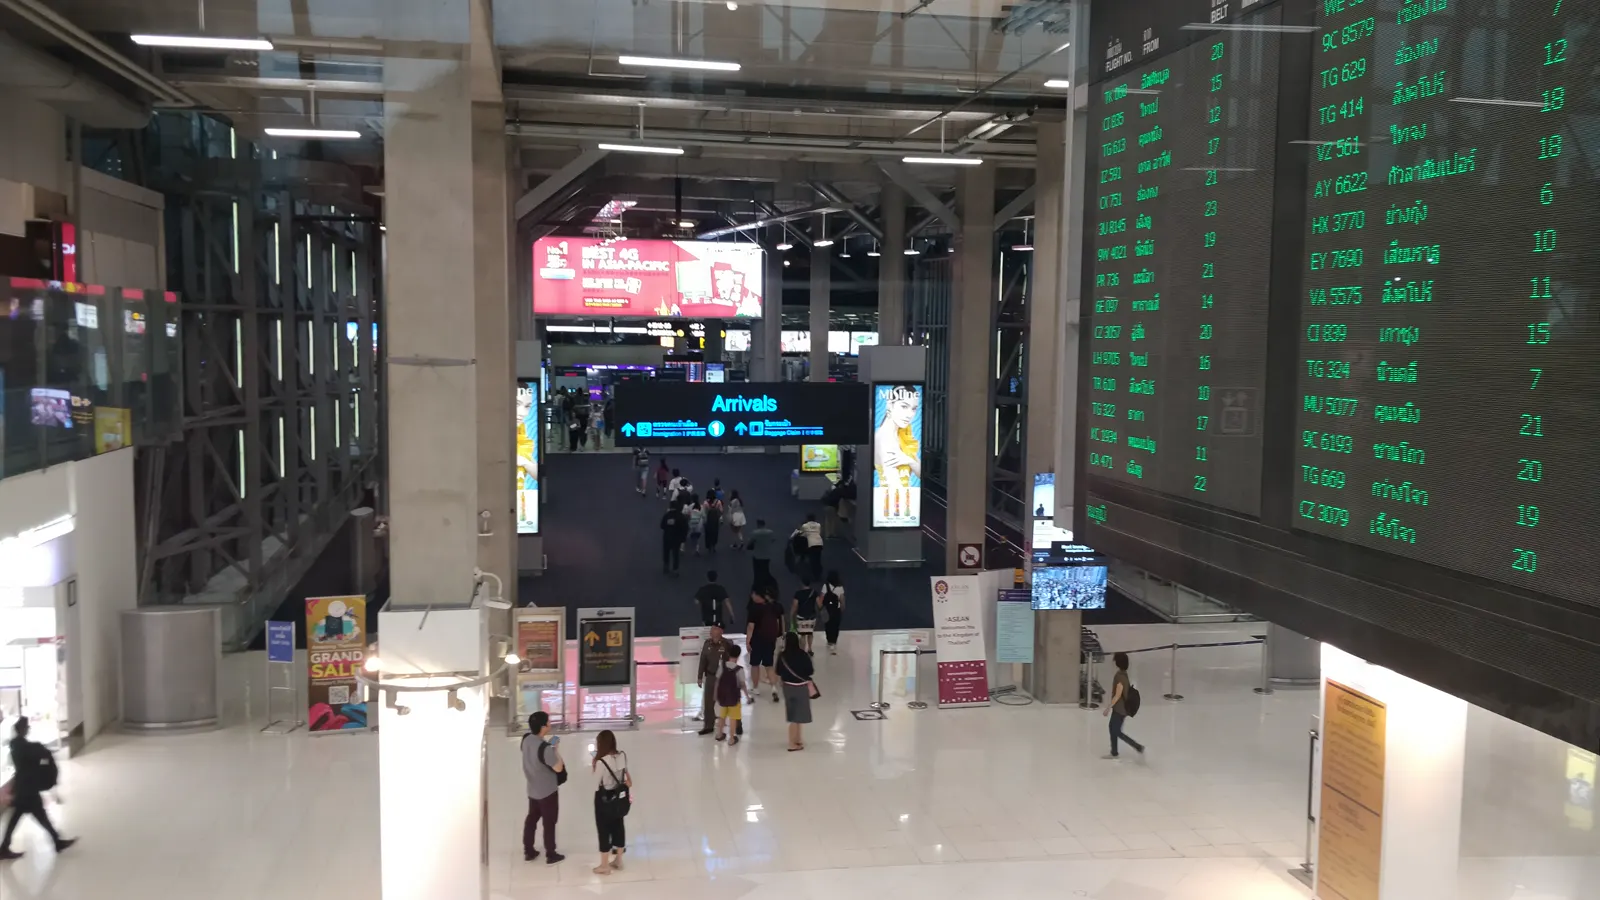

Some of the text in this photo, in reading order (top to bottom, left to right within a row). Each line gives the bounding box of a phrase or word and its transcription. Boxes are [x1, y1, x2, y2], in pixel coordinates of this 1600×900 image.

[1211, 4, 1229, 24] BELT
[1323, 30, 1338, 52] 9C
[1341, 17, 1374, 45] 8579
[1142, 38, 1159, 55] FROM
[1211, 42, 1224, 60] 20
[1105, 51, 1133, 72] FLIGHT NO.
[1321, 67, 1338, 88] TG
[1341, 58, 1366, 82] 629
[1394, 38, 1439, 66] ฮ่องกง
[1211, 74, 1222, 92] 15
[1320, 104, 1336, 124] TG
[1340, 97, 1363, 118] 414
[1544, 39, 1568, 65] 12
[1103, 142, 1112, 156] TG
[1113, 138, 1126, 154] 613
[1209, 106, 1221, 123] 12
[1317, 87, 1565, 161] VZ 561 ไทจง 18
[1208, 137, 1220, 154] 17
[1314, 180, 1331, 198] AY
[1335, 172, 1368, 194] 6622
[1538, 134, 1562, 159] 18
[1110, 193, 1122, 206] 751
[1205, 170, 1217, 185] 21
[1204, 200, 1217, 216] 23
[1312, 216, 1329, 233] HX
[1333, 210, 1365, 231] 3770
[1540, 183, 1553, 204] 6
[1205, 232, 1216, 247] 19
[582, 246, 639, 260] BEST 4G
[1310, 252, 1327, 270] EY
[1332, 249, 1363, 268] 7690
[1533, 230, 1556, 252] 10
[582, 259, 670, 271] IN ASIA-PACIFIC
[1202, 264, 1214, 278] 21
[1310, 289, 1326, 305] VA
[1330, 286, 1362, 305] 5575
[1530, 277, 1552, 299] 11
[1202, 294, 1213, 308] 14
[1200, 324, 1212, 339] 20
[1307, 324, 1319, 341] CI
[1322, 324, 1347, 341] 839
[1527, 322, 1550, 344] 15
[1200, 356, 1210, 370] 16
[1307, 360, 1324, 377] TG
[1326, 361, 1350, 378] 324
[1530, 369, 1542, 389] 7
[1198, 386, 1210, 400] 10
[711, 395, 778, 412] Arrivals
[1197, 416, 1208, 430] 17
[1304, 395, 1323, 413] MU
[1326, 397, 1358, 416] 5077
[1520, 414, 1543, 436] 21
[1196, 446, 1206, 461] 11
[1303, 431, 1318, 448] 9C
[1320, 433, 1352, 454] 6193
[1517, 459, 1542, 482] 20
[1194, 475, 1206, 491] 22
[1302, 465, 1319, 484] TG
[1320, 469, 1345, 489] 669
[1516, 505, 1539, 527] 19
[1299, 500, 1315, 519] CZ
[1318, 504, 1349, 526] 3079
[1512, 549, 1536, 572] 20
[310, 650, 363, 664] GRAND
